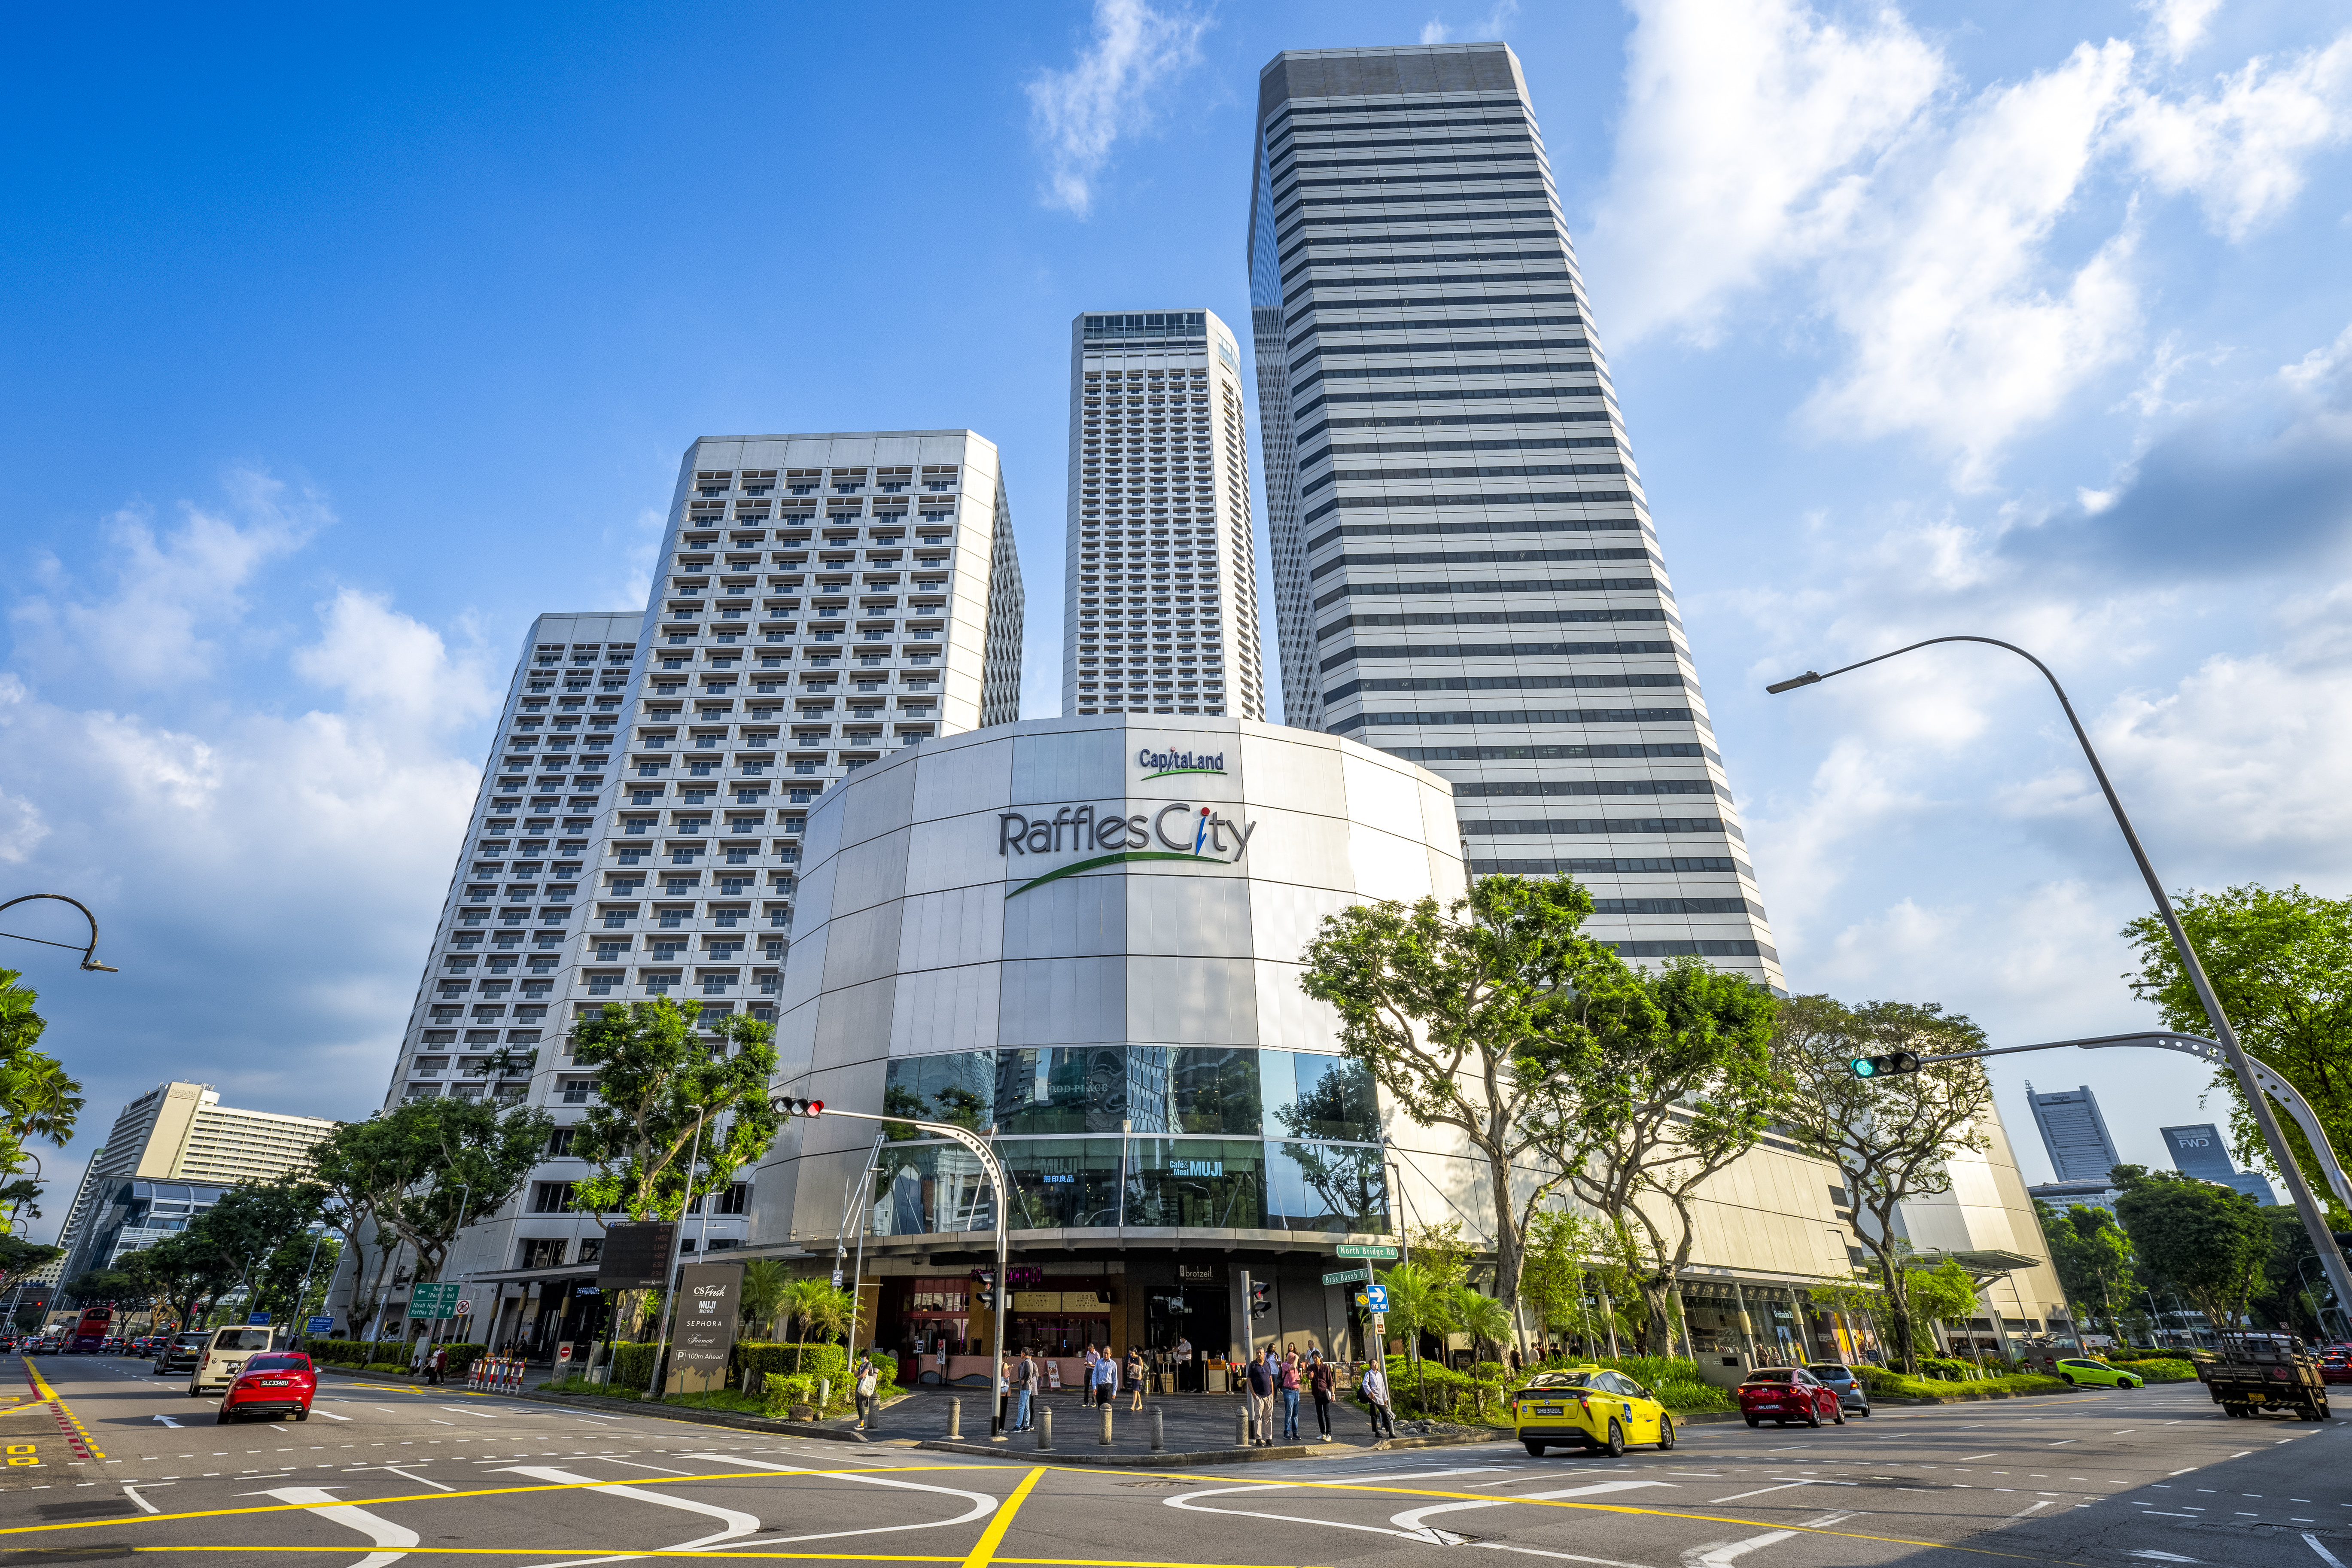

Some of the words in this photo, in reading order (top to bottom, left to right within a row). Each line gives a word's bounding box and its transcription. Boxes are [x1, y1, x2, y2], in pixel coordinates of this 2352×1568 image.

[1140, 746, 1224, 772] CapitaLand
[998, 805, 1150, 856] Raffles
[1156, 803, 1257, 862] City
[1074, 1084, 1108, 1092] PLACE
[2179, 1138, 2209, 1148] FWD
[1040, 1158, 1077, 1174] MUJI
[1190, 1161, 1223, 1176] MUJI
[1043, 1175, 1074, 1183] 無印良品
[1340, 1246, 1359, 1254] North
[1363, 1247, 1384, 1257] Bridge
[1340, 1272, 1357, 1281] Basah
[1360, 1270, 1368, 1278] Rd
[581, 1287, 600, 1295] PROVIDORE
[704, 1285, 726, 1297] Fresh
[698, 1300, 716, 1309] MUJI
[687, 1333, 715, 1344] Fairmont
